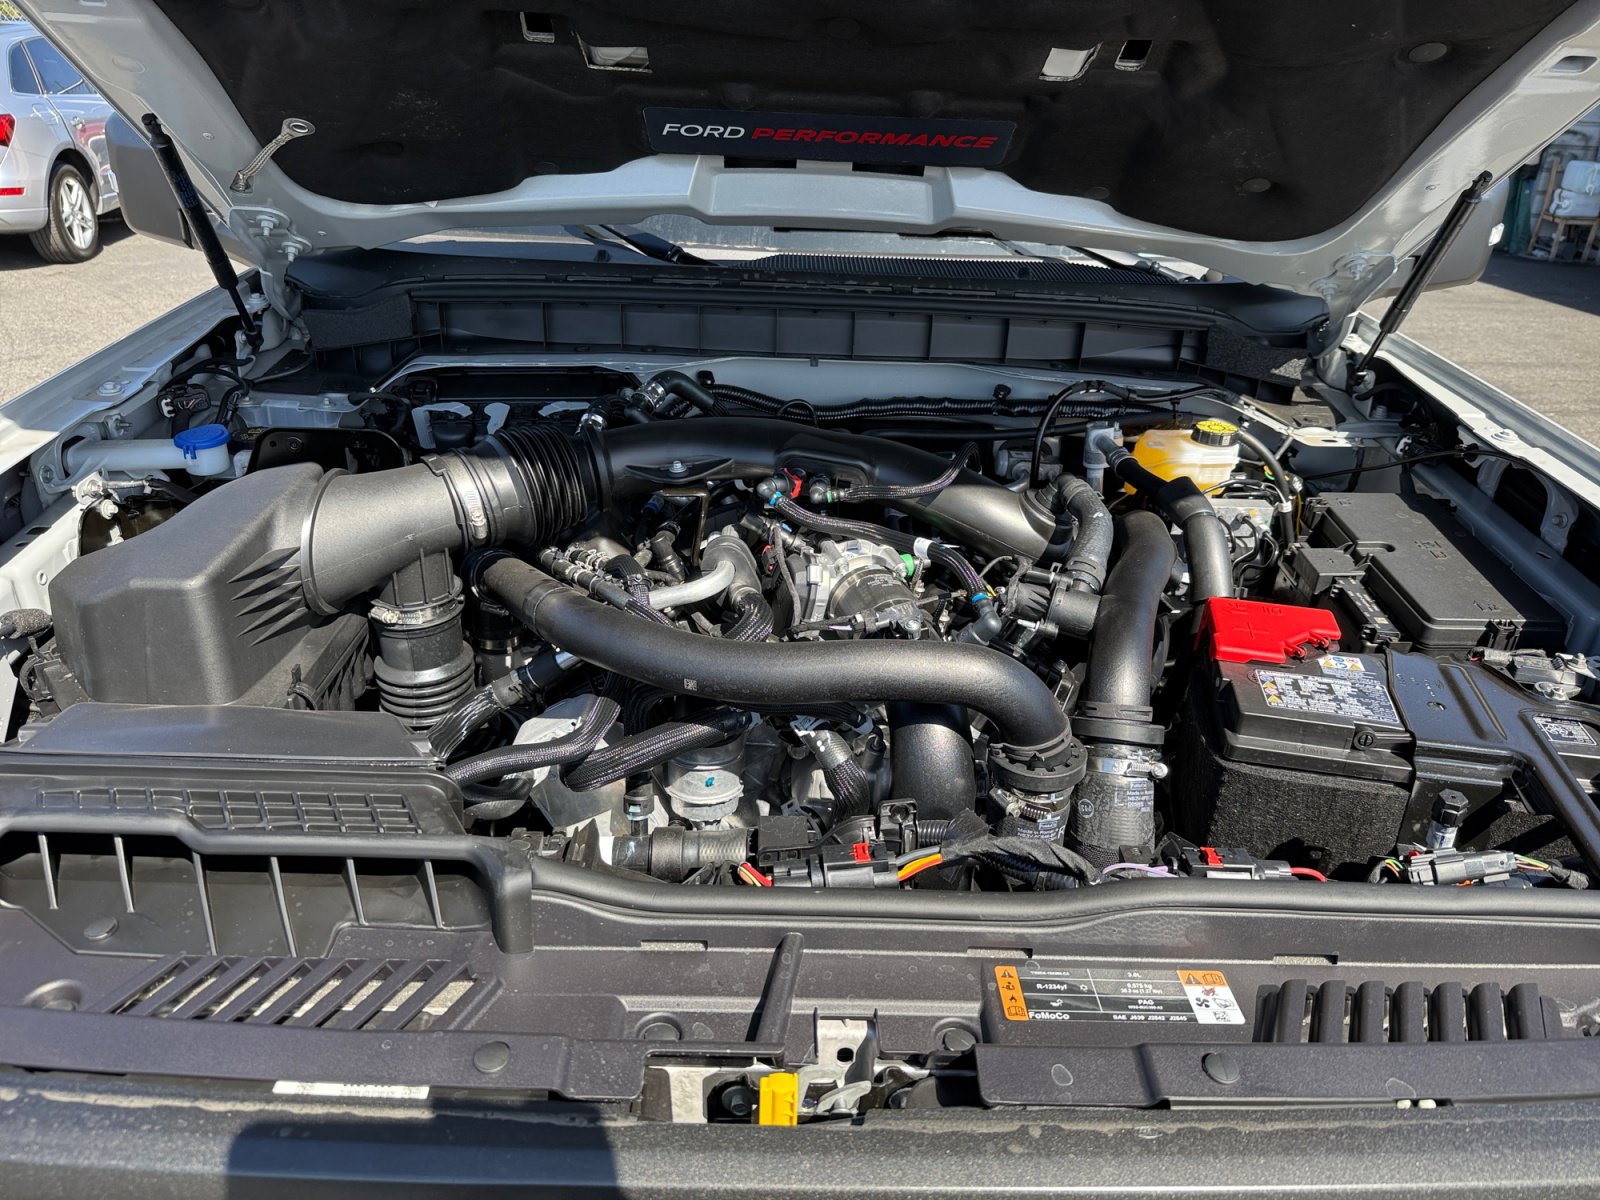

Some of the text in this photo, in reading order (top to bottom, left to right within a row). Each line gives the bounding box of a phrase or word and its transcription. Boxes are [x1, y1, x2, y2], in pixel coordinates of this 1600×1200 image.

[662, 123, 998, 149] FORD PERFORMANCE
[1036, 983, 1068, 991] R-1234yf
[1029, 1011, 1070, 1020] FoMoCo
